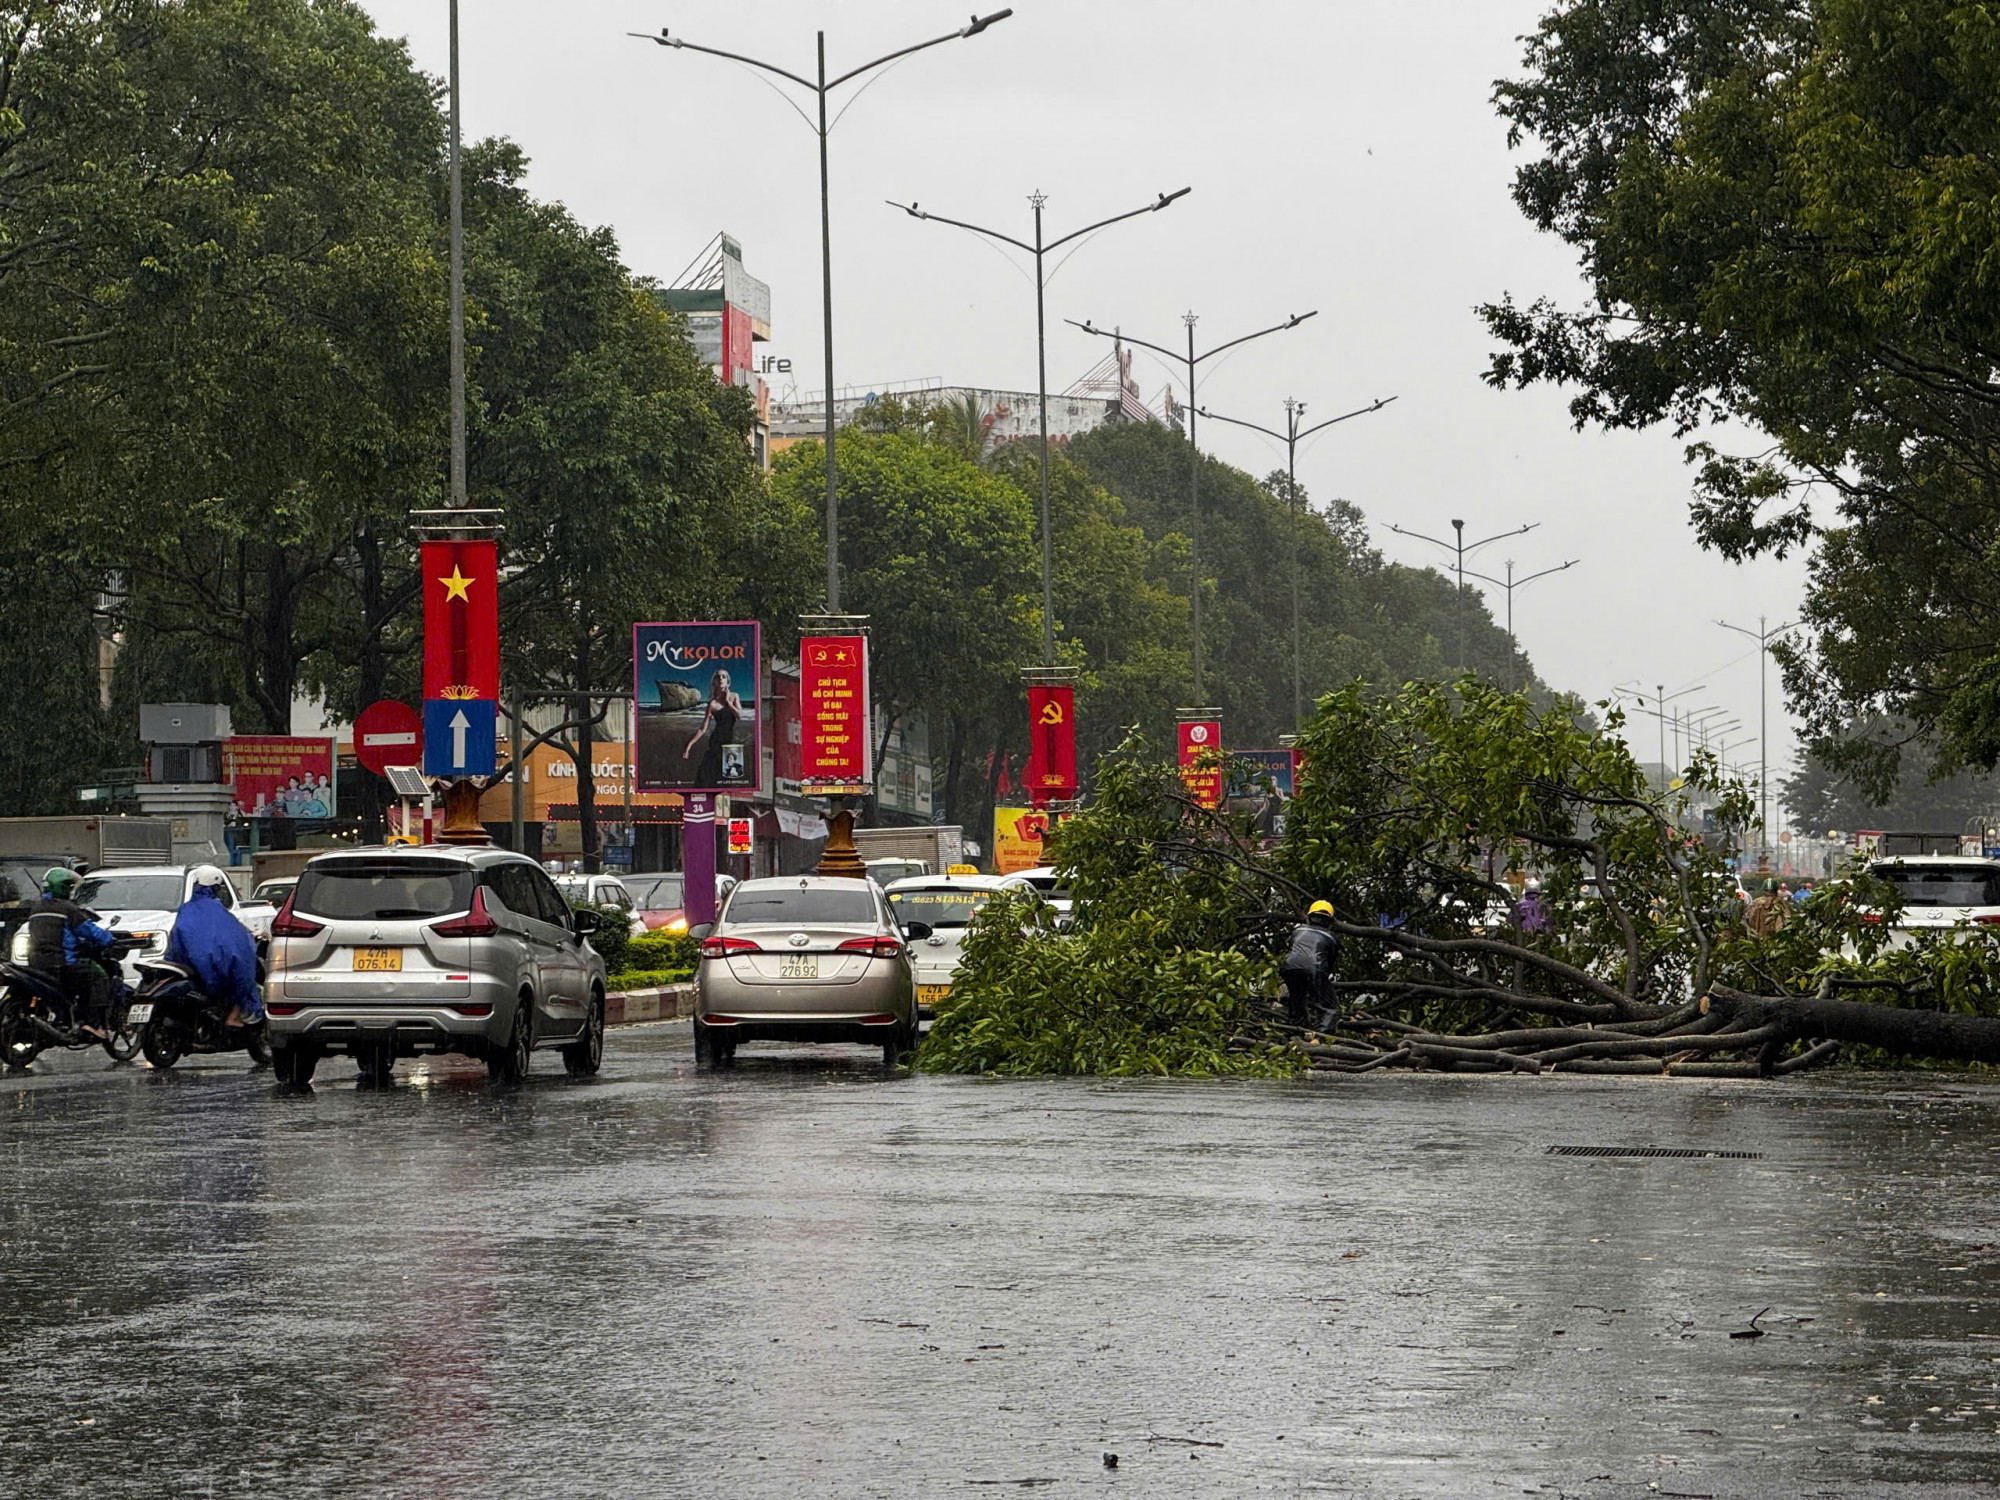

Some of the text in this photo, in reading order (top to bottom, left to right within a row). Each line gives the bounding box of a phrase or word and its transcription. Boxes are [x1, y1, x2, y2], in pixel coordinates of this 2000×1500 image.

[826, 745, 839, 754] CỦA
[816, 757, 849, 766] CHÚNG TA!
[548, 760, 577, 777] KÍNH
[619, 784, 635, 795] GA
[693, 804, 704, 813] 34
[358, 959, 396, 969] 076.14
[789, 954, 808, 964] 47A
